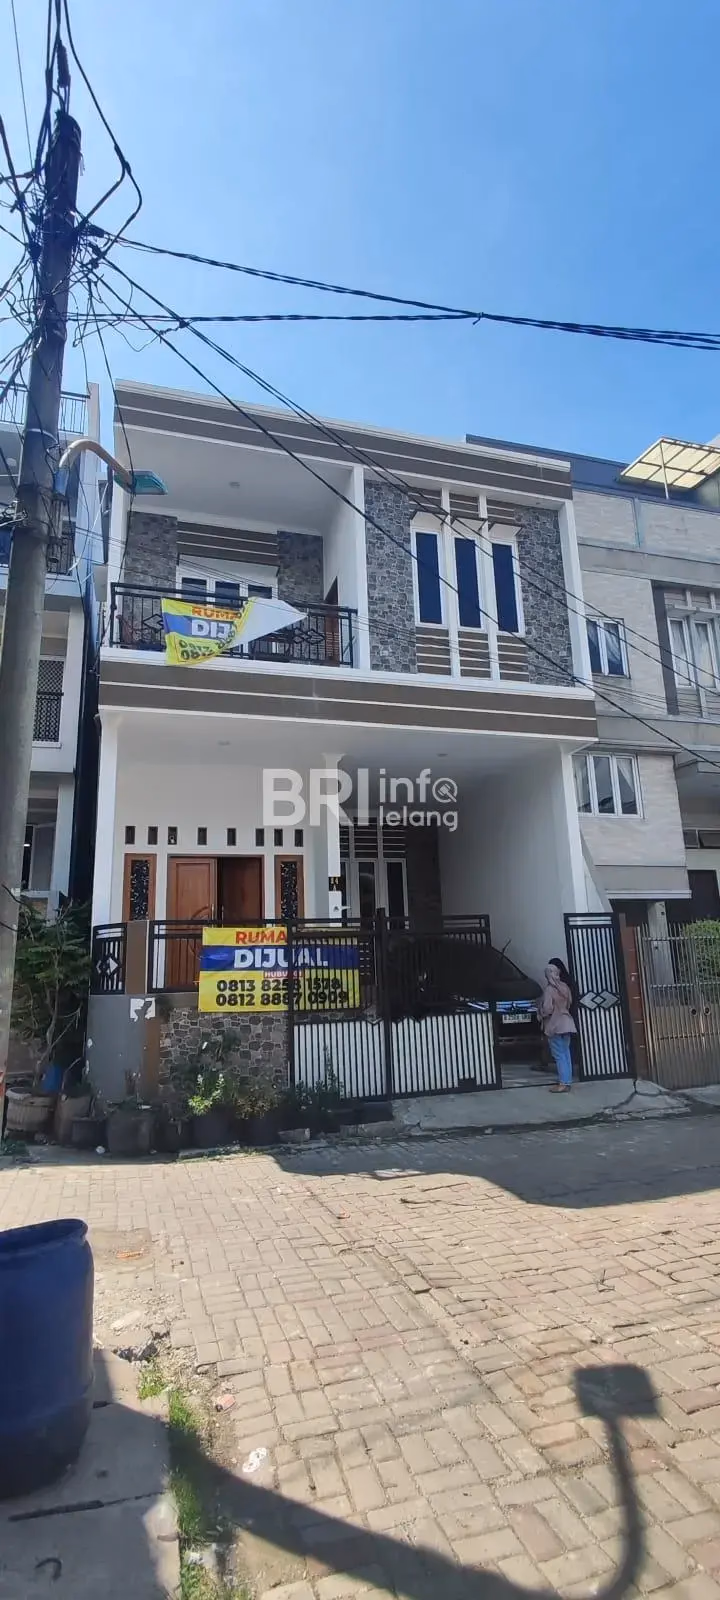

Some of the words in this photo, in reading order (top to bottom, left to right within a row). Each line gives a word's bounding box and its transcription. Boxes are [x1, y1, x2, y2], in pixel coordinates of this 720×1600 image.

[234, 948, 329, 968] DIJUAL
[216, 979, 256, 992] 0813
[215, 993, 256, 1006] 0812
